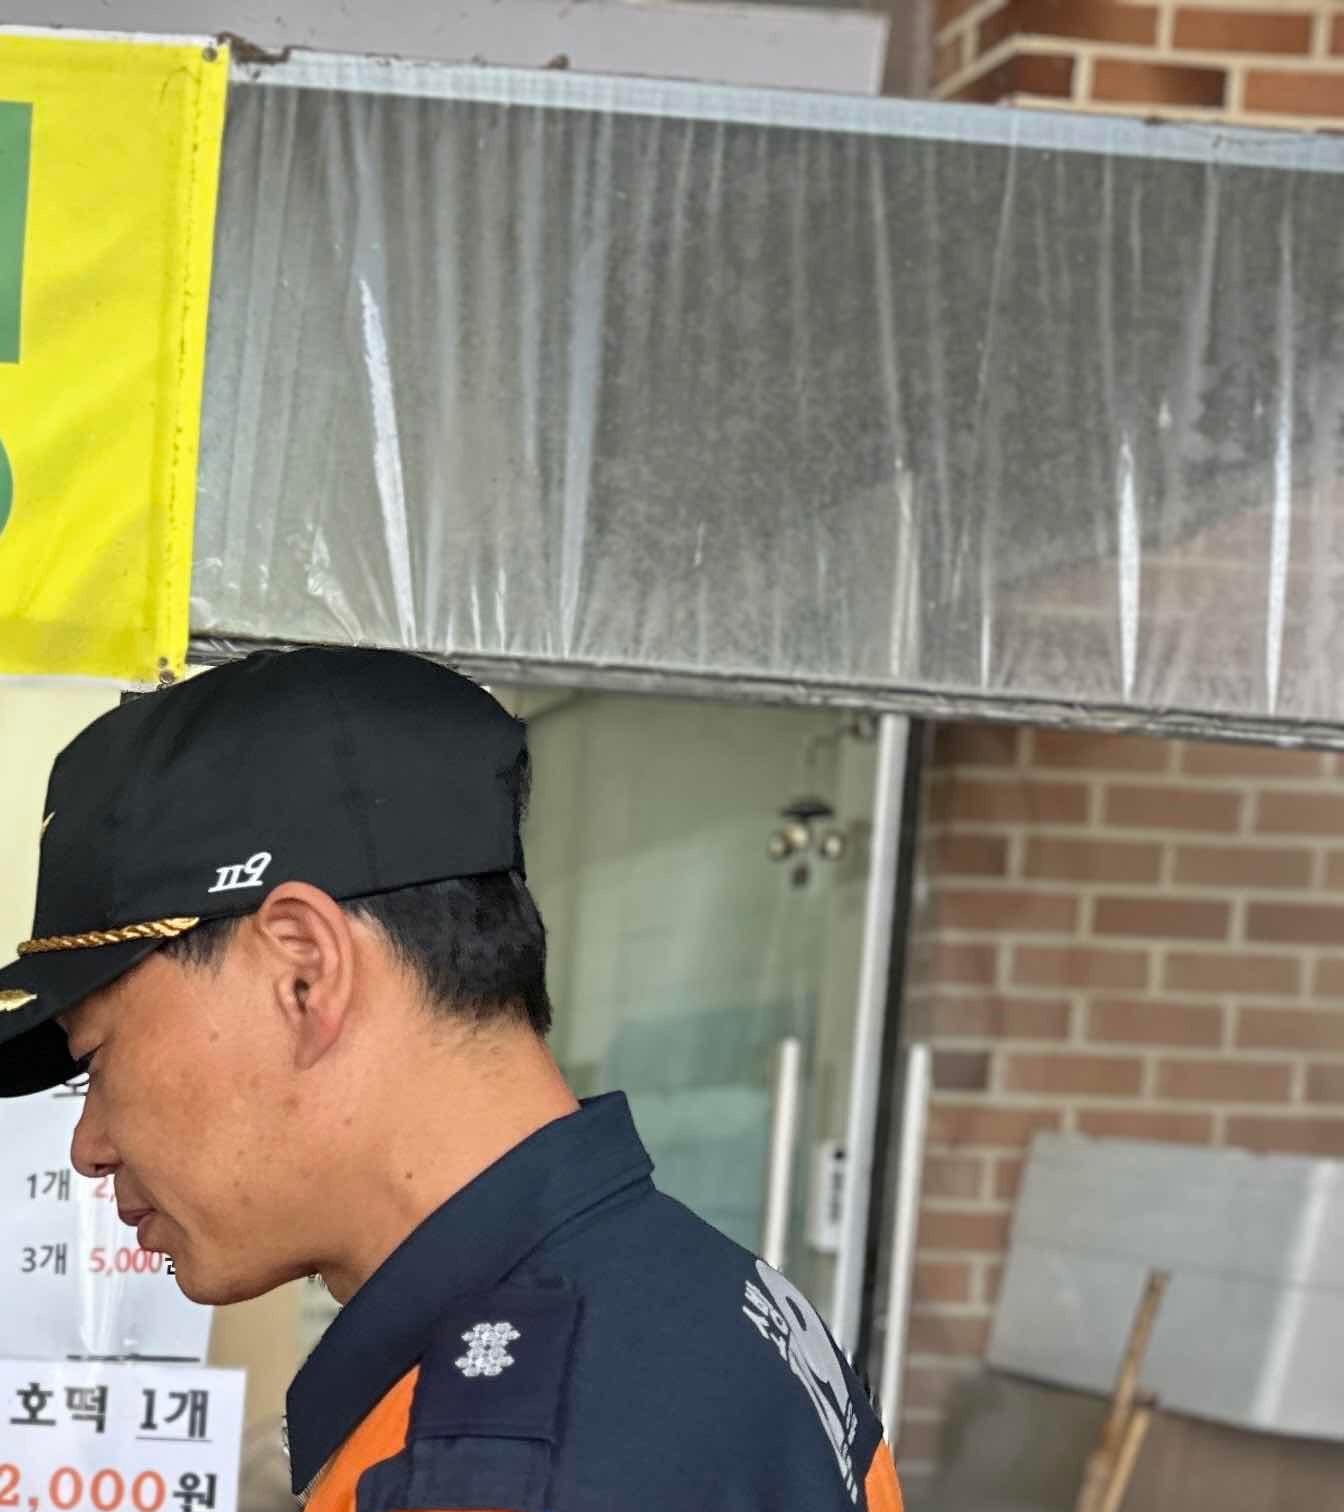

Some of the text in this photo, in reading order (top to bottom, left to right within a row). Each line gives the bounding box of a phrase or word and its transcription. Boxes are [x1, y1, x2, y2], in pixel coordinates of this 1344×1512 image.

[208, 852, 272, 893] 119
[26, 1170, 71, 1201] 1개
[21, 1243, 68, 1275] 3개
[10, 1381, 209, 1440] 호떡 1개
